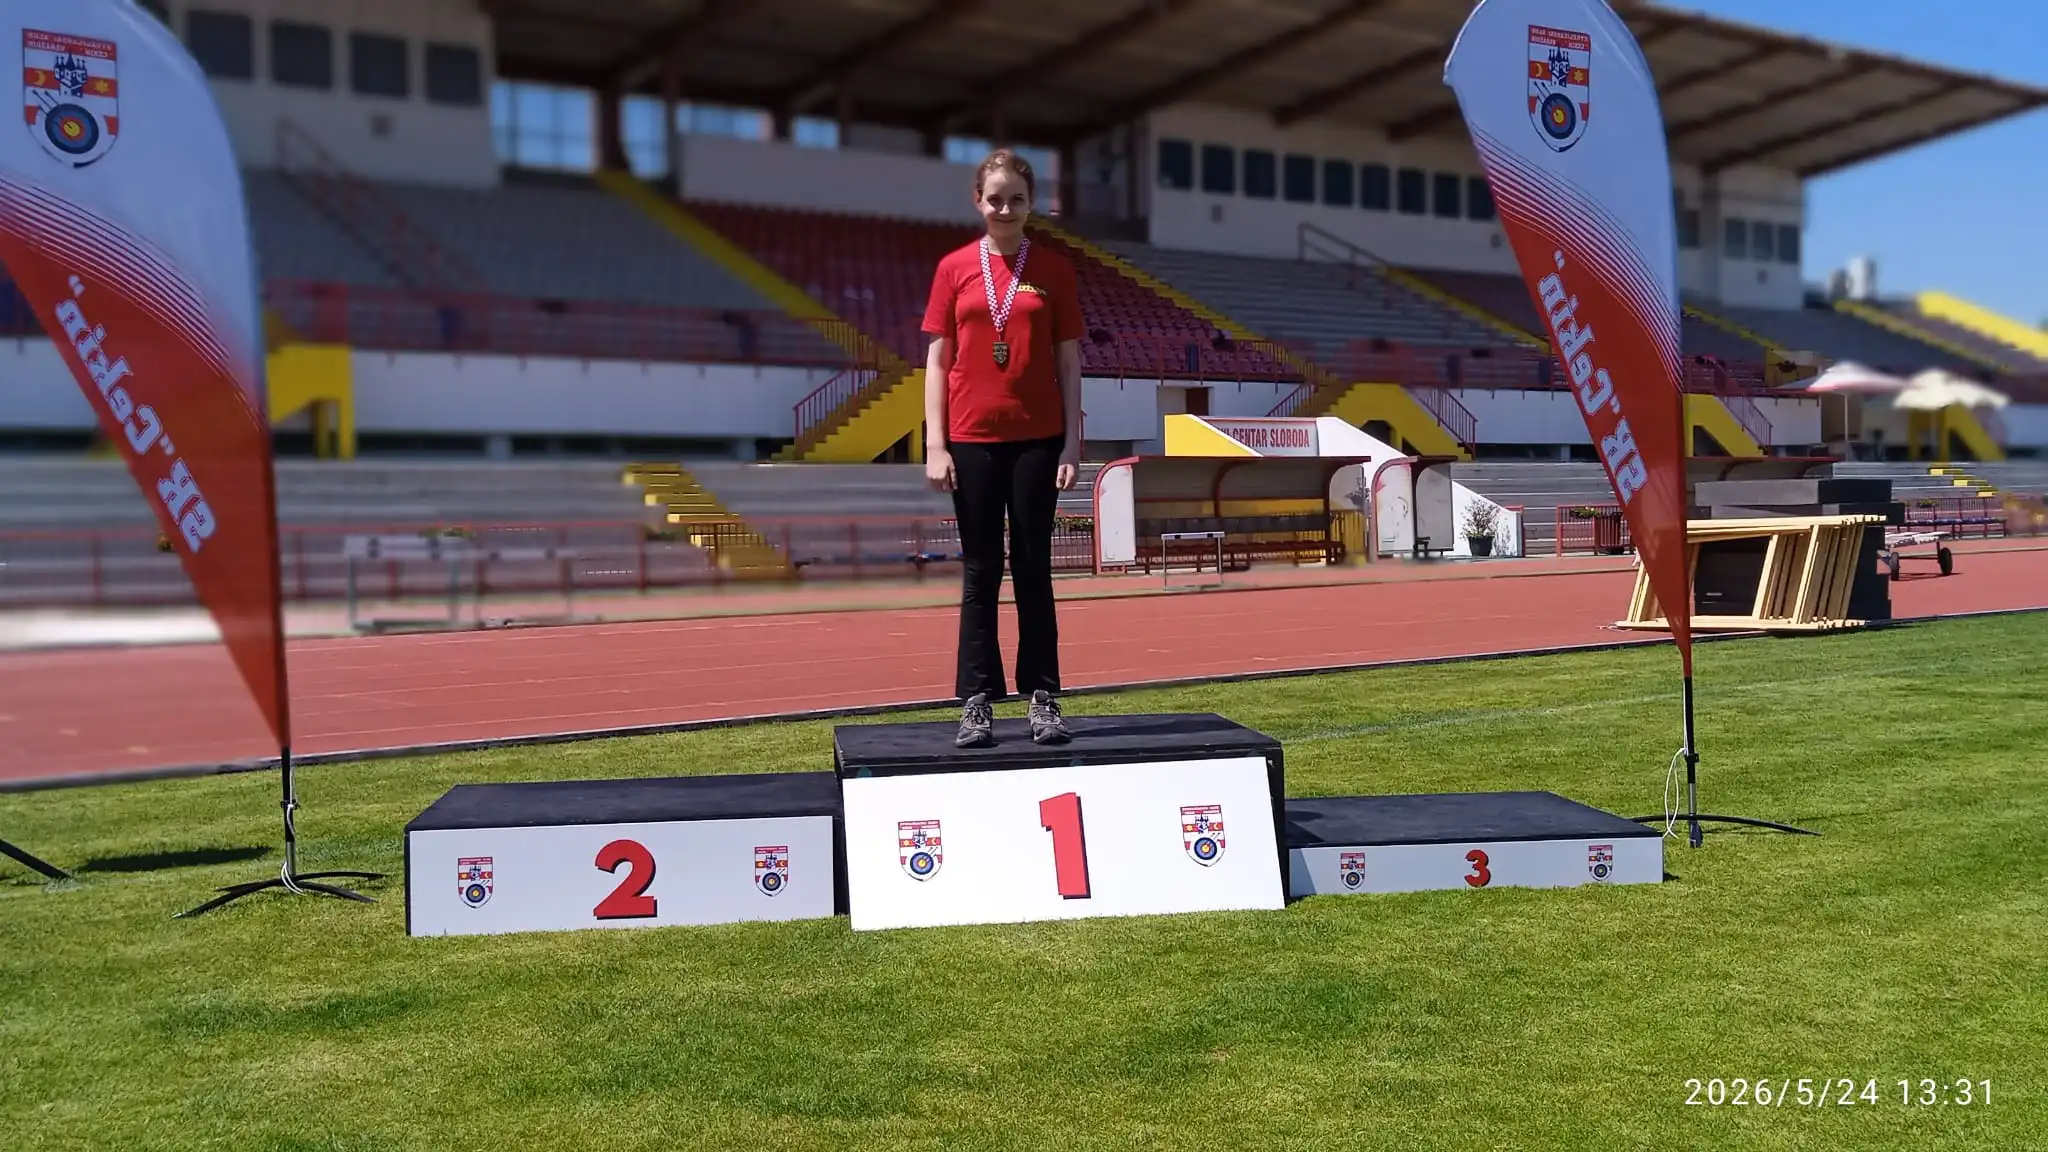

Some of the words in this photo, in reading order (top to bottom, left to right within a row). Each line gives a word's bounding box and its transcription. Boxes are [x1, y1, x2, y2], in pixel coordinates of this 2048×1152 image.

[1270, 428, 1310, 448] SLOBODA
[1039, 792, 1091, 900] 1
[1464, 849, 1492, 888] 3
[593, 839, 658, 920] 2
